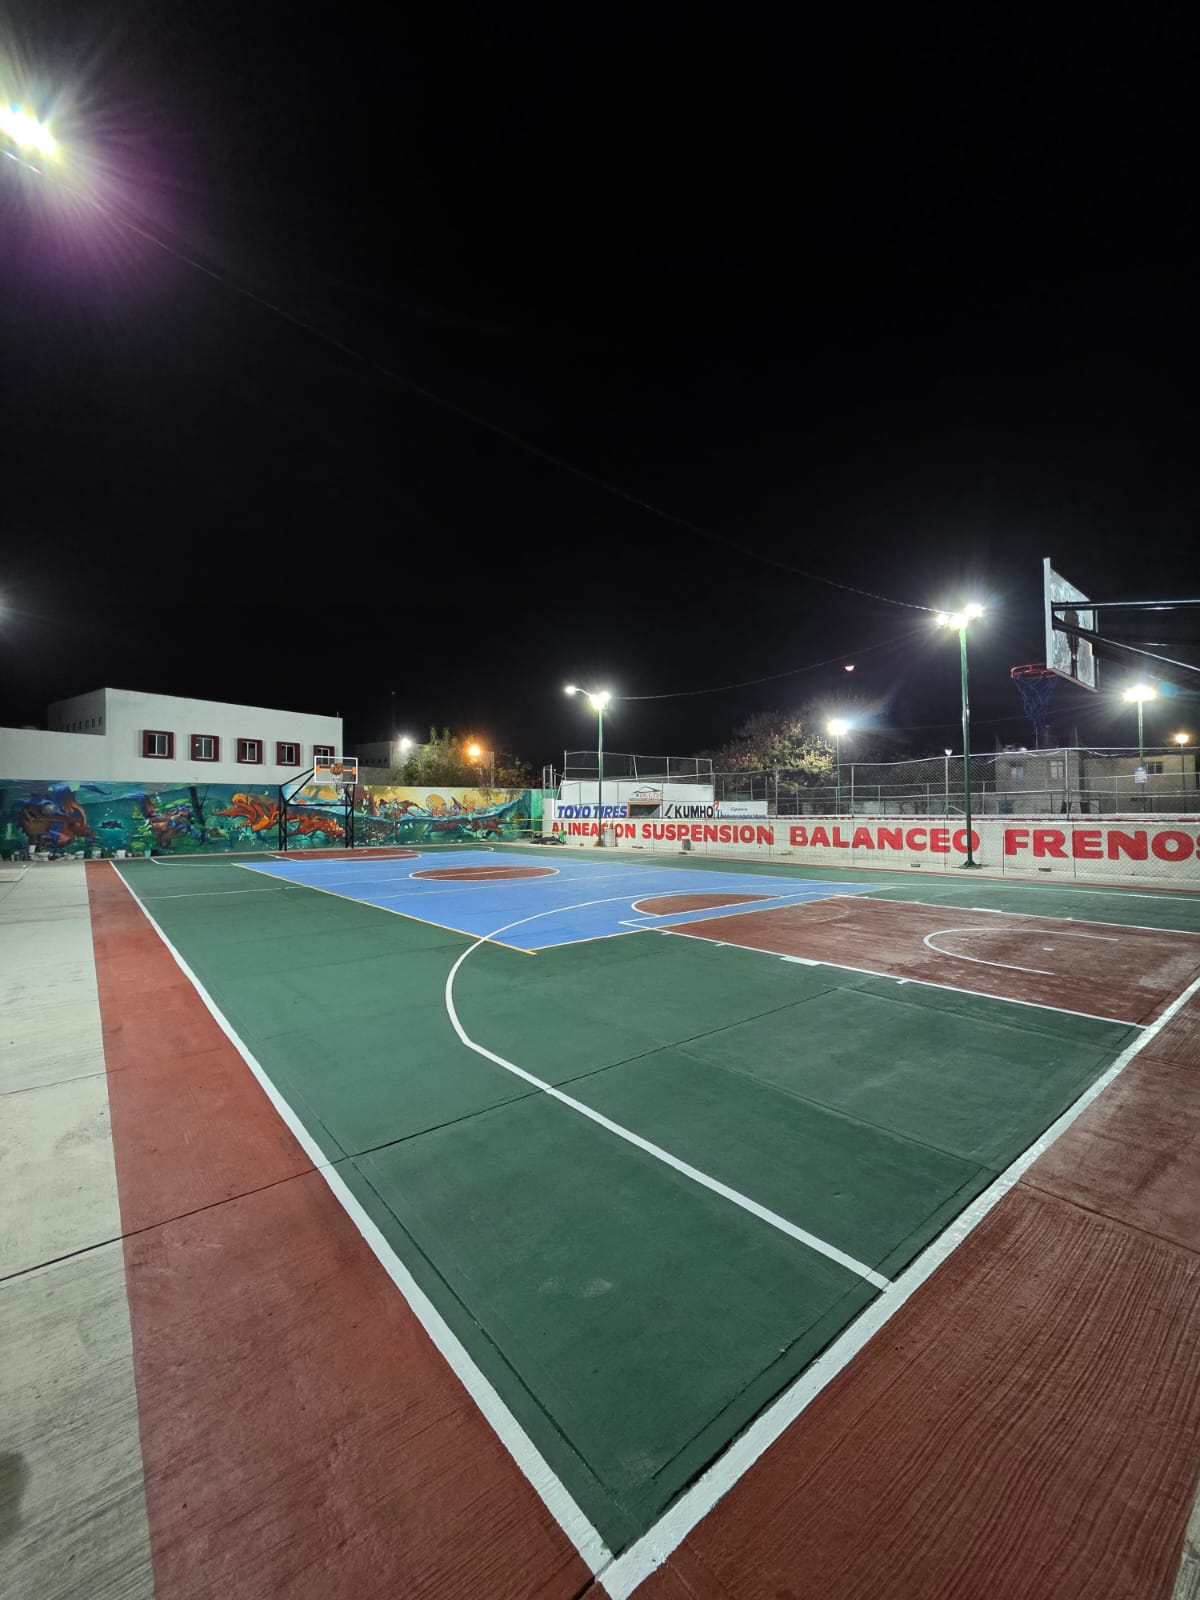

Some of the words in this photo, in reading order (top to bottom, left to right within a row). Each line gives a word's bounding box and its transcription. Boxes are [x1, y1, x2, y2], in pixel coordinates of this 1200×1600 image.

[557, 805, 593, 819] TOYO
[593, 805, 628, 819] TIRES
[674, 804, 714, 819] KUMHO
[641, 823, 774, 845] SUSPENSION
[789, 826, 980, 853] BALANCEO
[1004, 829, 1200, 862] FRENO
